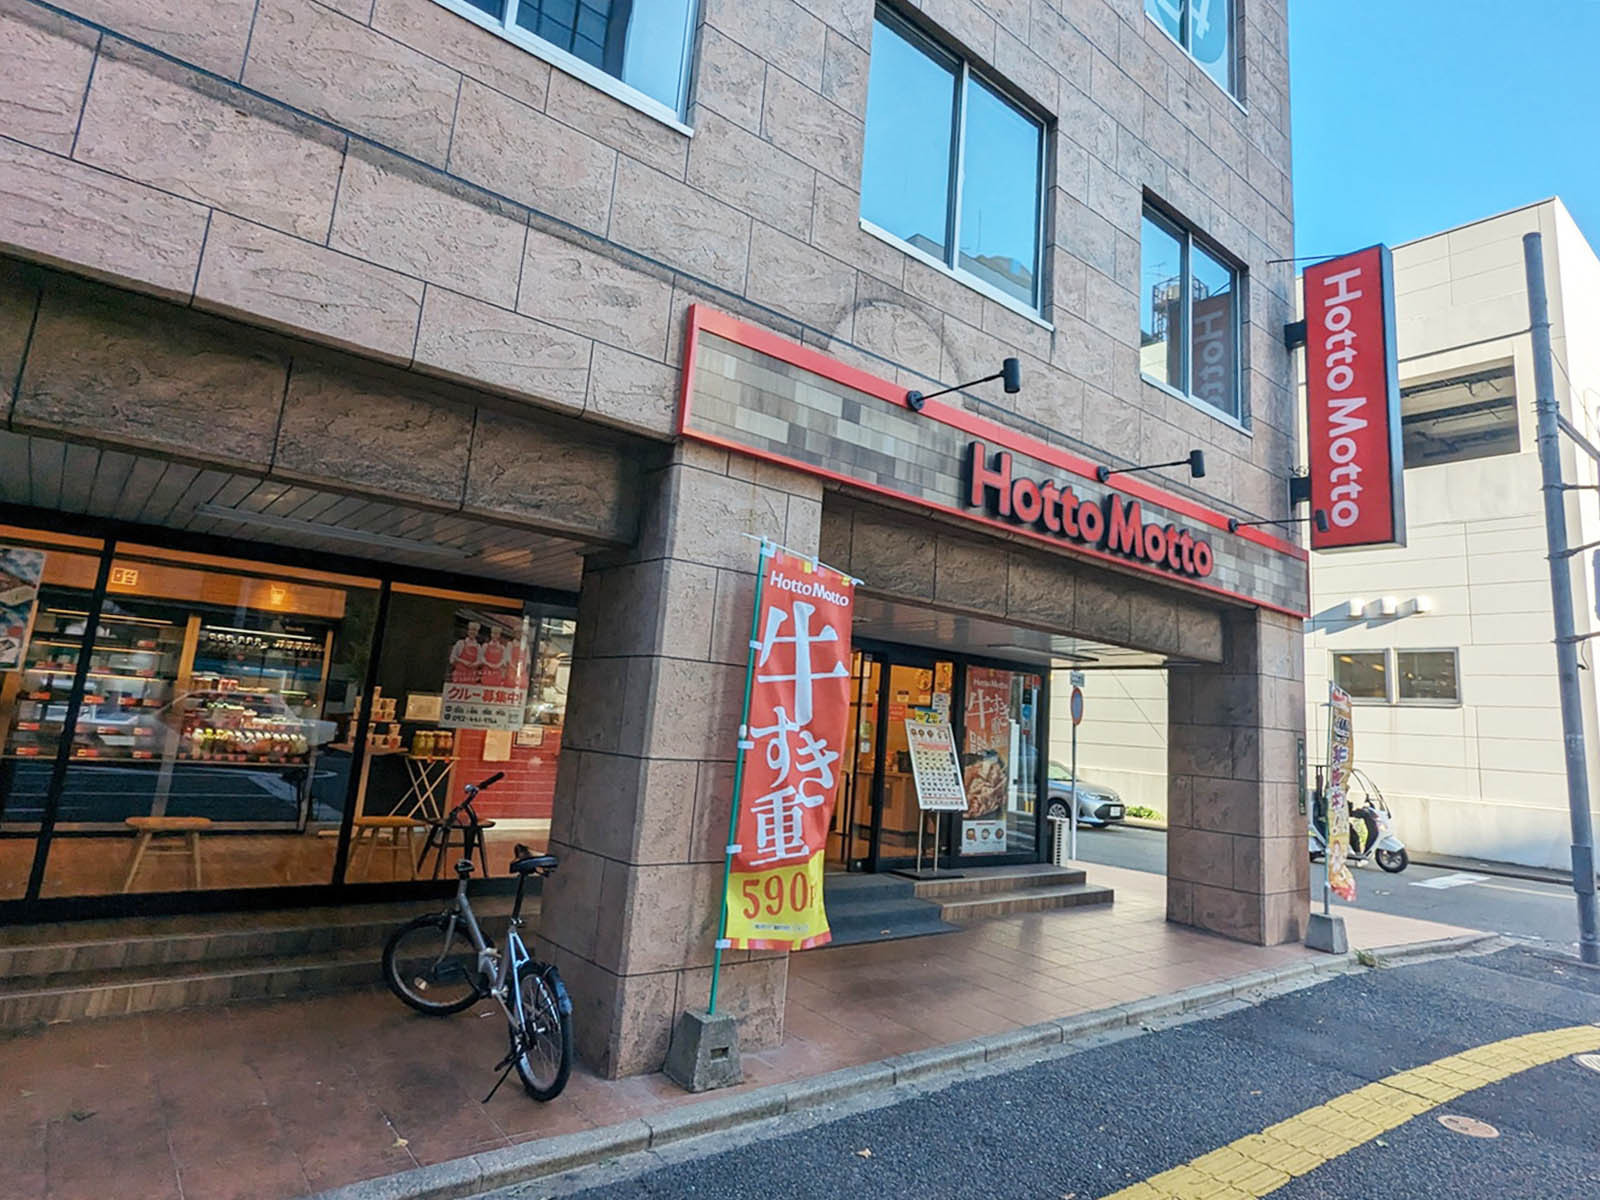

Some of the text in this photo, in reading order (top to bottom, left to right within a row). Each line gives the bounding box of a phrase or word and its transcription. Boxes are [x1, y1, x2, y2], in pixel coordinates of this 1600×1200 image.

[969, 441, 1214, 577] Hotto Motto
[1323, 267, 1369, 528] Hotto Motto
[749, 601, 849, 866] 牛すき重
